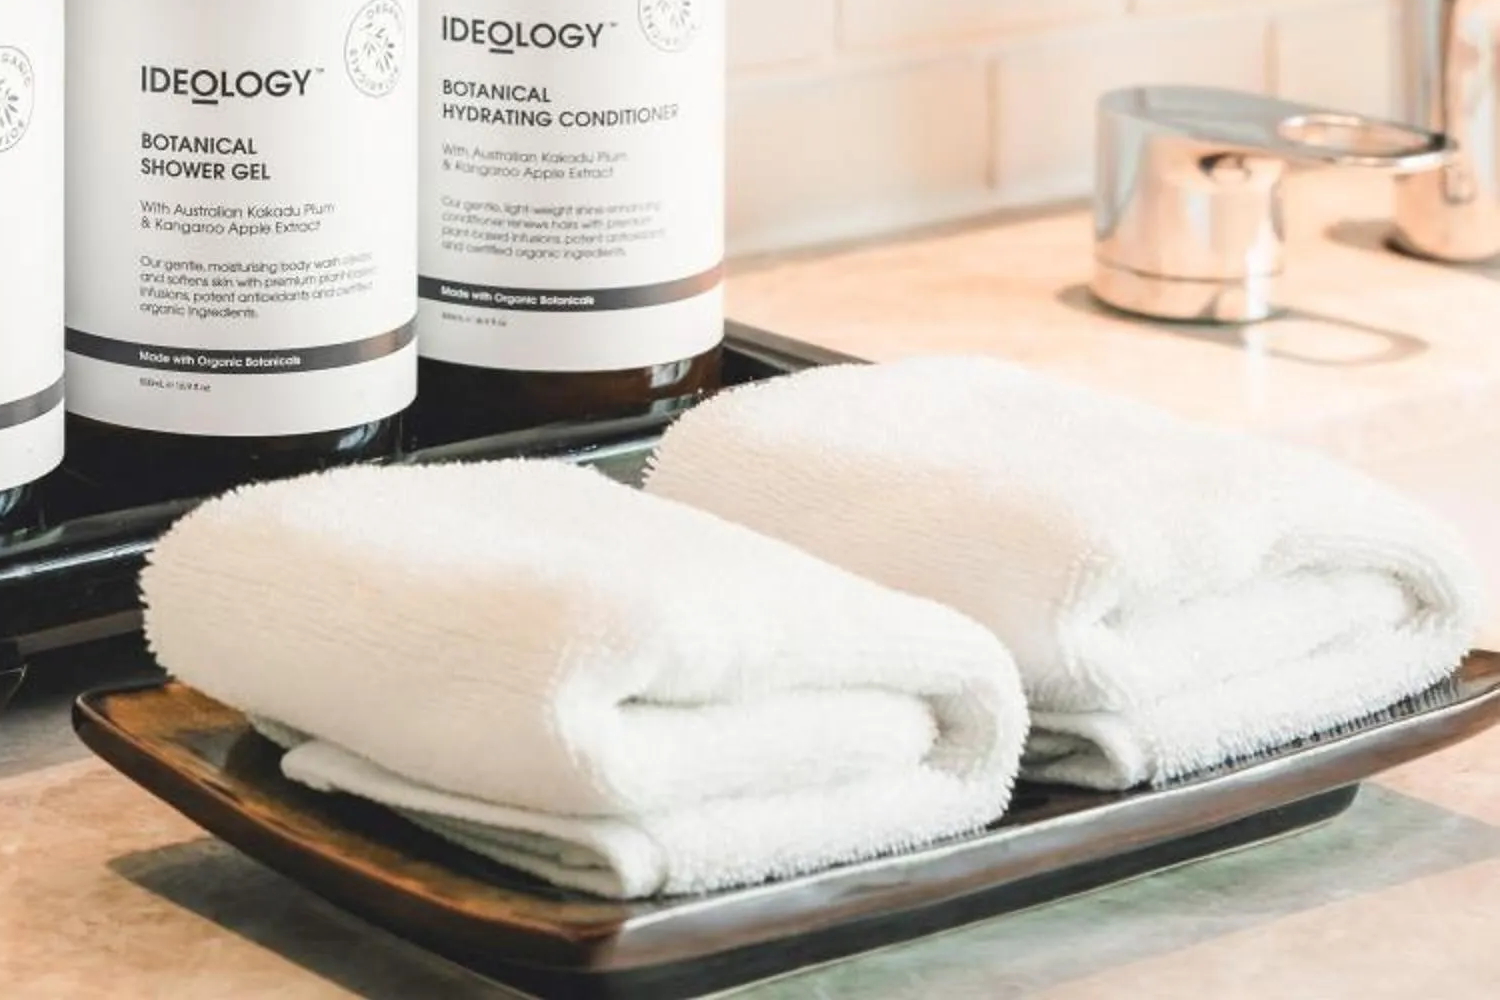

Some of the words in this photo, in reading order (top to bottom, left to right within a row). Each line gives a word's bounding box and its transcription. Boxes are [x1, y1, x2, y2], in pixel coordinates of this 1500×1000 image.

[442, 79, 551, 103] BOTANICAL
[442, 103, 552, 128] HYDRATING
[558, 103, 680, 129] CONDITIONER
[140, 132, 259, 156] BOTANICAL
[441, 143, 470, 158] With
[471, 146, 537, 162] Australian
[541, 150, 594, 164] Kakadu
[139, 157, 226, 181] SHOWER
[230, 161, 272, 182] GEL
[454, 160, 521, 177] Kangaroo
[523, 167, 565, 182] Apple
[568, 166, 614, 179] Extract
[139, 199, 171, 215] With
[173, 204, 243, 219] Australian
[247, 204, 301, 219] Kakadu
[303, 202, 336, 216] Plum
[140, 215, 151, 229] &
[155, 218, 225, 235] Kangaroo
[227, 221, 271, 237] Apple
[275, 220, 321, 234] Extract
[139, 255, 162, 269] Our
[208, 261, 278, 275] moisturising
[280, 260, 310, 274] body
[139, 272, 164, 283] and
[167, 274, 209, 287] softens
[211, 276, 235, 288] skin
[236, 276, 263, 289] with
[265, 275, 316, 289] premium
[193, 292, 235, 304] potent
[237, 290, 310, 303] antioxidants
[440, 284, 470, 299] Made
[471, 289, 493, 303] with
[493, 290, 538, 307] Organic
[539, 295, 596, 306] Botanicals
[139, 303, 186, 317] organic
[139, 351, 171, 364] Made
[172, 353, 195, 366] with
[196, 353, 243, 369] Organic
[244, 354, 302, 368] Botanicals
